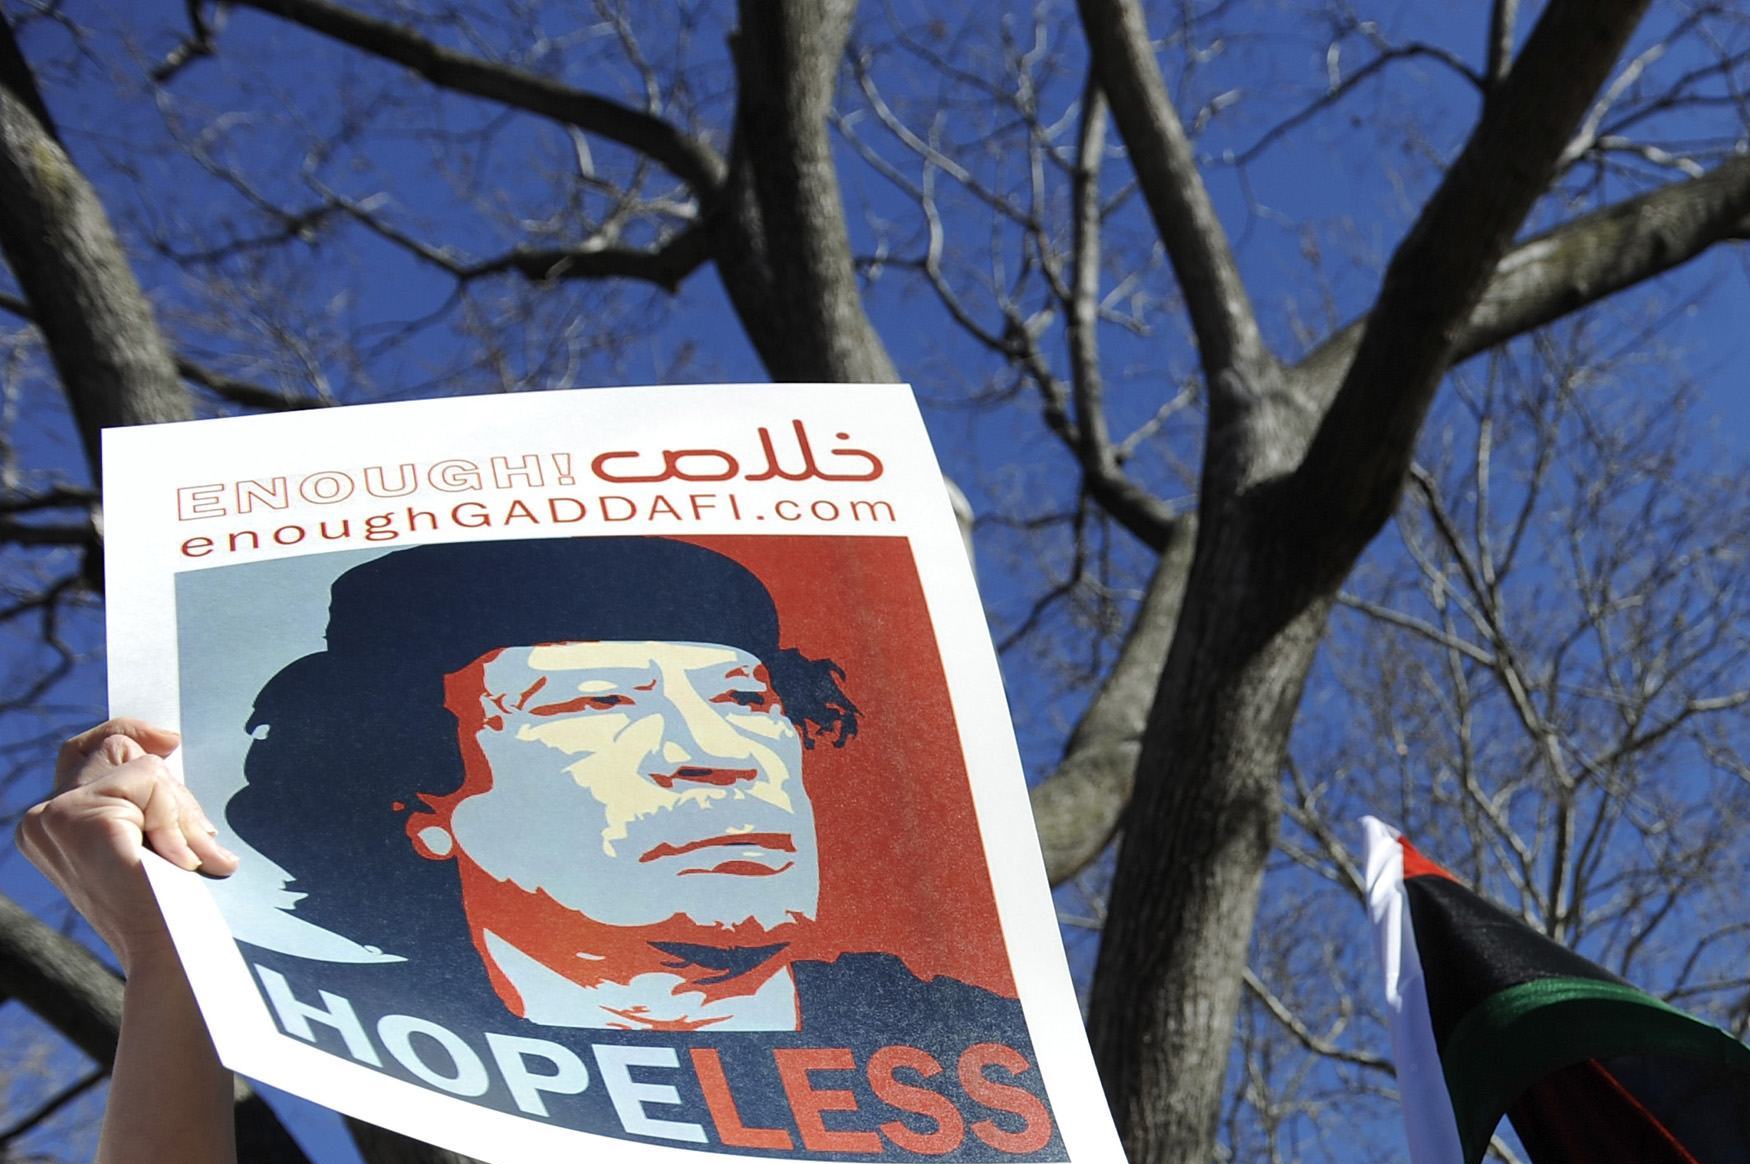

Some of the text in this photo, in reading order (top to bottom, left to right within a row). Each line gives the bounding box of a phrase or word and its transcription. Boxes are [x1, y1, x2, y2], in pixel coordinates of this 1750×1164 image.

[590, 418, 884, 484] خلاص
[177, 452, 576, 522] ENOUGH!
[180, 493, 897, 558] enoughGADDAFI.com
[258, 963, 1053, 1155] HOPELESS
